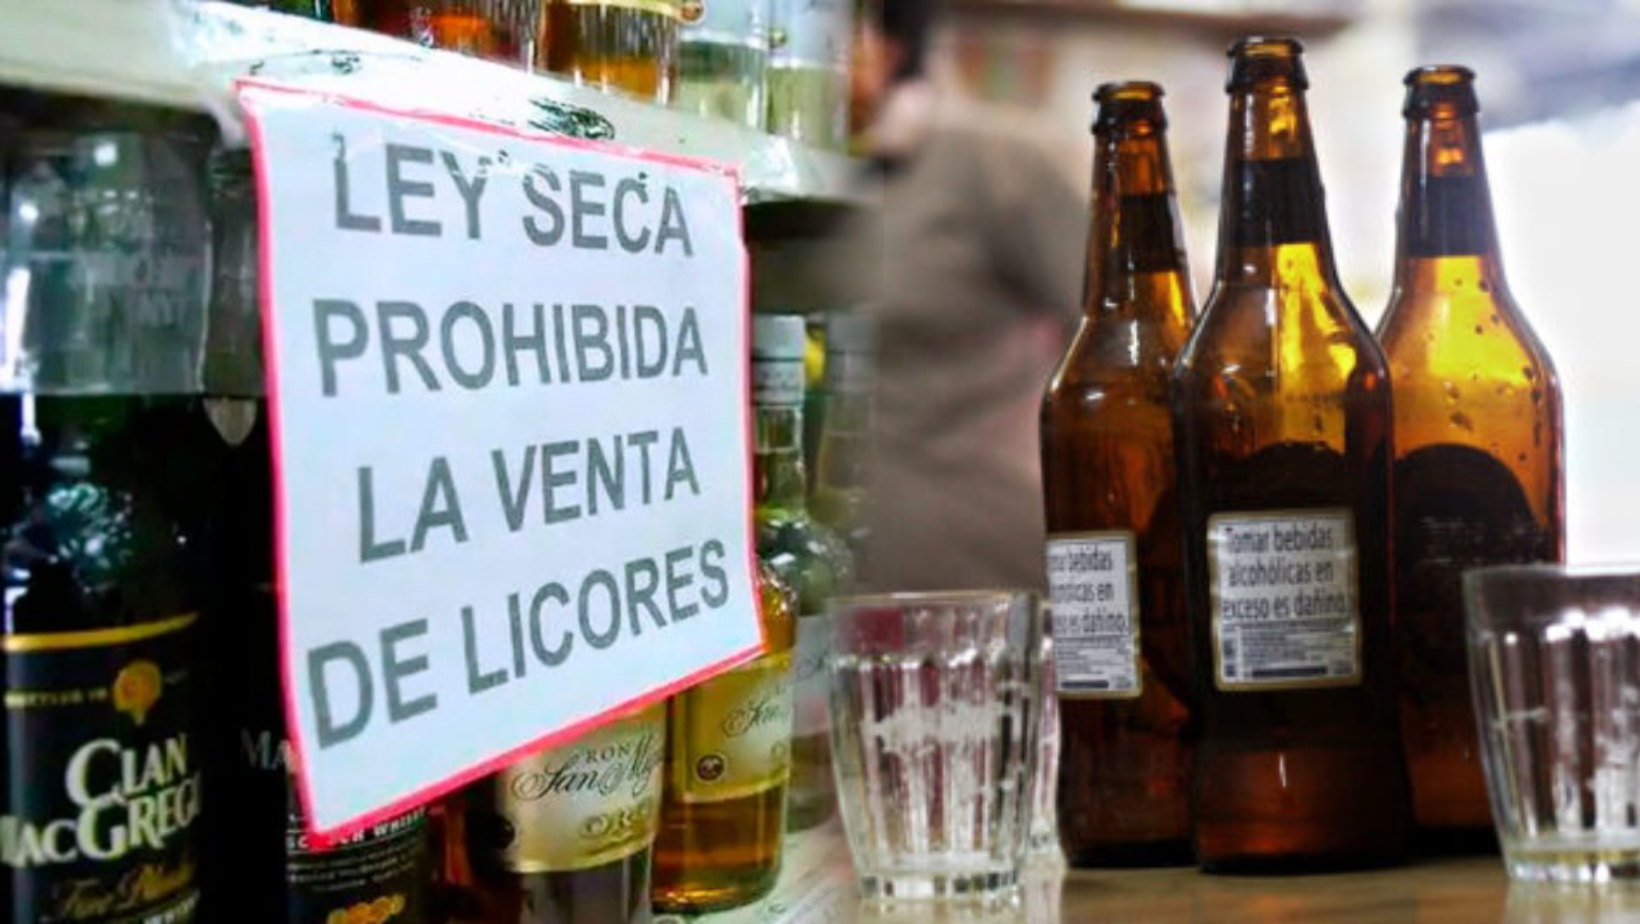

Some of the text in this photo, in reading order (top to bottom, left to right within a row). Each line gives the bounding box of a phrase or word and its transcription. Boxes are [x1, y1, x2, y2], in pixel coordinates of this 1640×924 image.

[332, 132, 693, 257] LEY SECA
[312, 299, 709, 398] PROHIBIDA
[356, 426, 702, 564] LA VENTA
[1273, 521, 1333, 552] bebidas
[1096, 582, 1115, 602] en
[1315, 560, 1335, 583] en
[1273, 594, 1291, 616] es
[307, 538, 731, 750] DE LICORES
[64, 733, 189, 809] CLAN
[585, 741, 631, 765] RON
